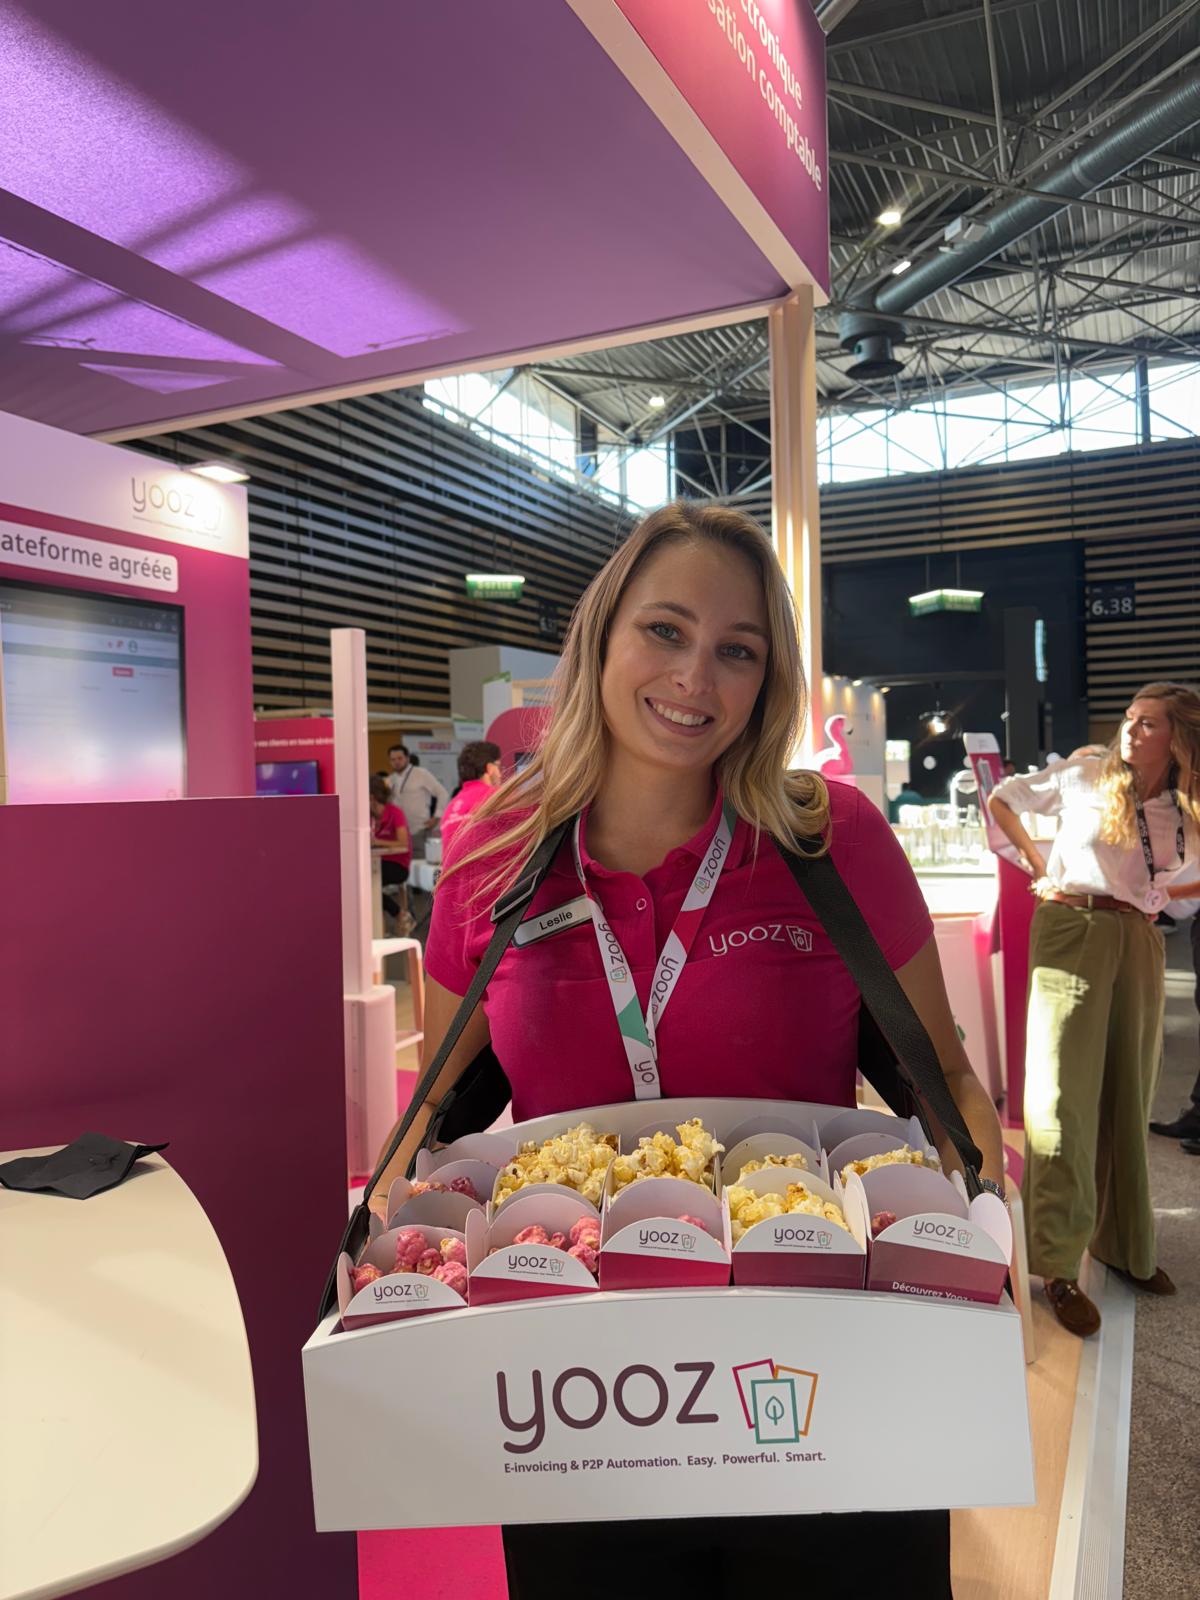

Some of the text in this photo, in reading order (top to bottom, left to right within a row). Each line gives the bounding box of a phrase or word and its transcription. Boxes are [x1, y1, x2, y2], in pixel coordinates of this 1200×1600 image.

[759, 69, 822, 191] comptable
[1, 533, 172, 582] ateforme agréée
[1092, 597, 1132, 616] 6.38
[703, 836, 726, 879] yooz
[539, 911, 573, 931] Leslie
[598, 923, 624, 965] yooz
[708, 924, 786, 957] yooz
[651, 956, 679, 1003] yooz
[634, 1060, 655, 1083] yo
[639, 1229, 679, 1245] yooz
[774, 1228, 815, 1243] yooz
[913, 1219, 956, 1235] yooz
[508, 1254, 548, 1270] yooz
[373, 1284, 412, 1301] yooz
[892, 1281, 943, 1298] Découvrez
[497, 1361, 719, 1454] yooz
[504, 1451, 826, 1474] E-invoicing & P2P Automation. Easy. Powerful. Smart.
